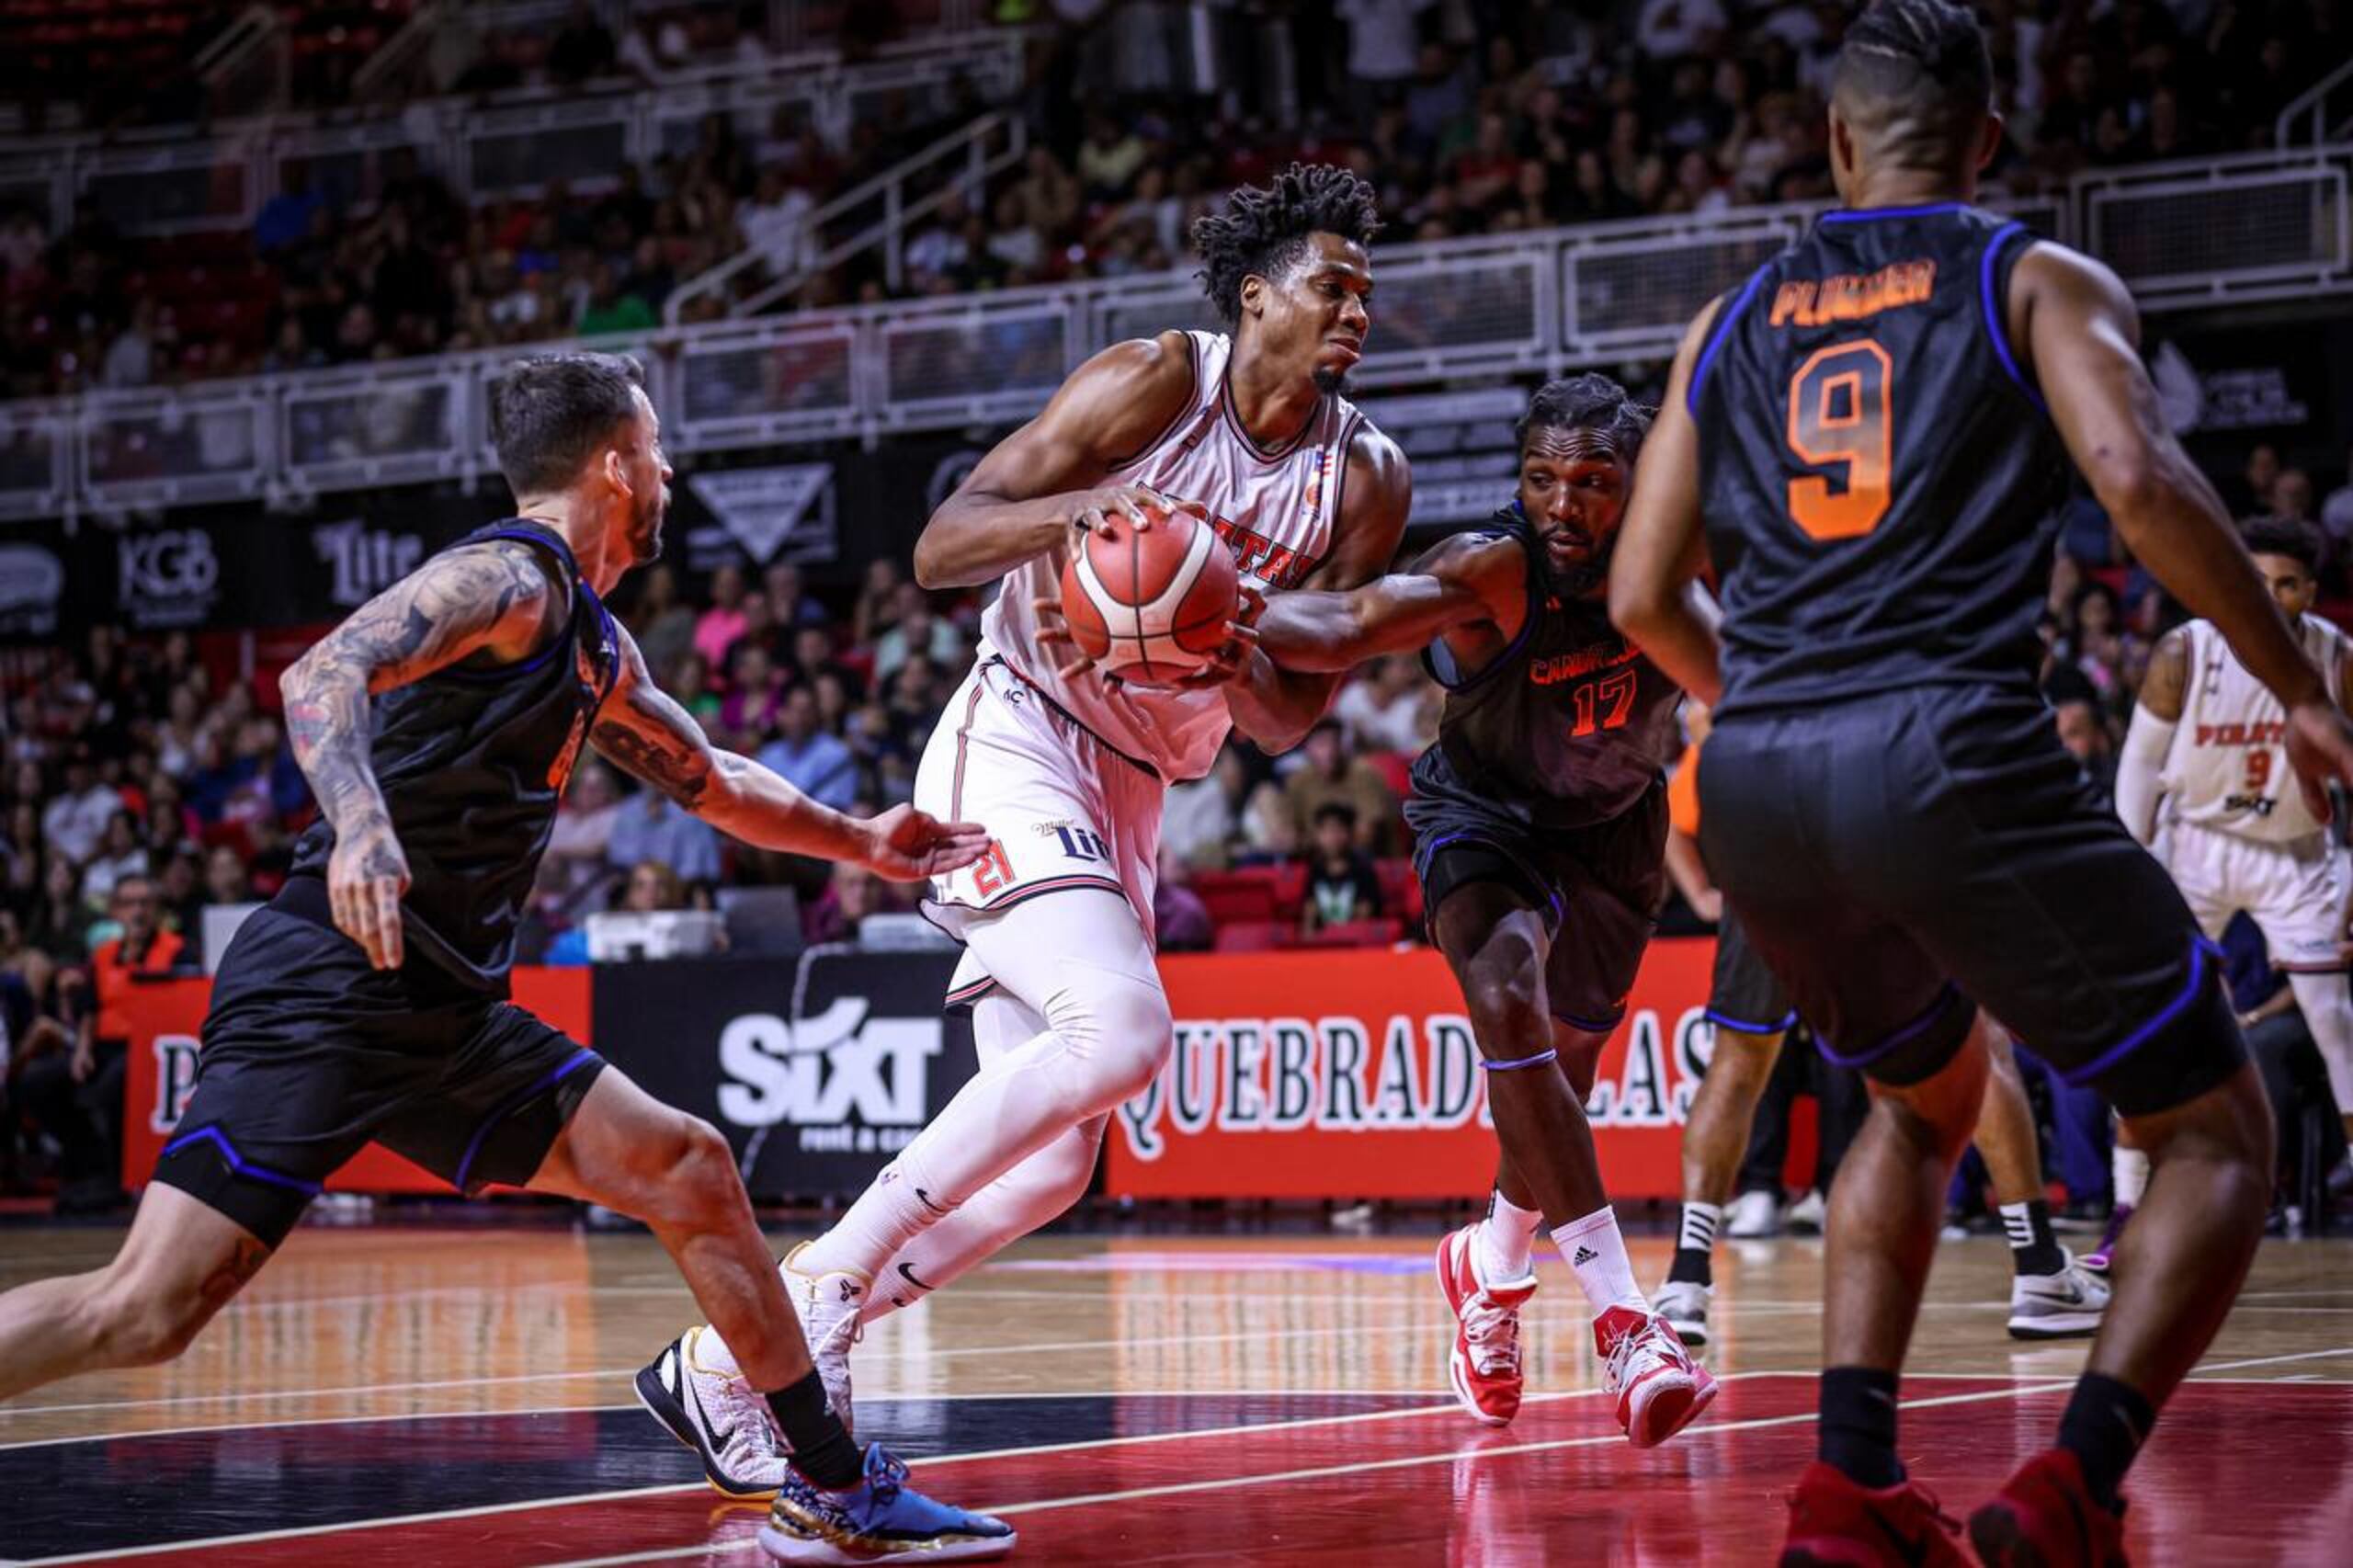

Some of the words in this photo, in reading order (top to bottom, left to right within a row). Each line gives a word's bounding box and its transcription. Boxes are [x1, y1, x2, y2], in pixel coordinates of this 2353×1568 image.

[1787, 338, 1893, 541] 9
[1572, 668, 1637, 737] 17
[2195, 721, 2286, 746] PIRAT
[2245, 750, 2271, 789] 9
[972, 837, 1017, 899] 21
